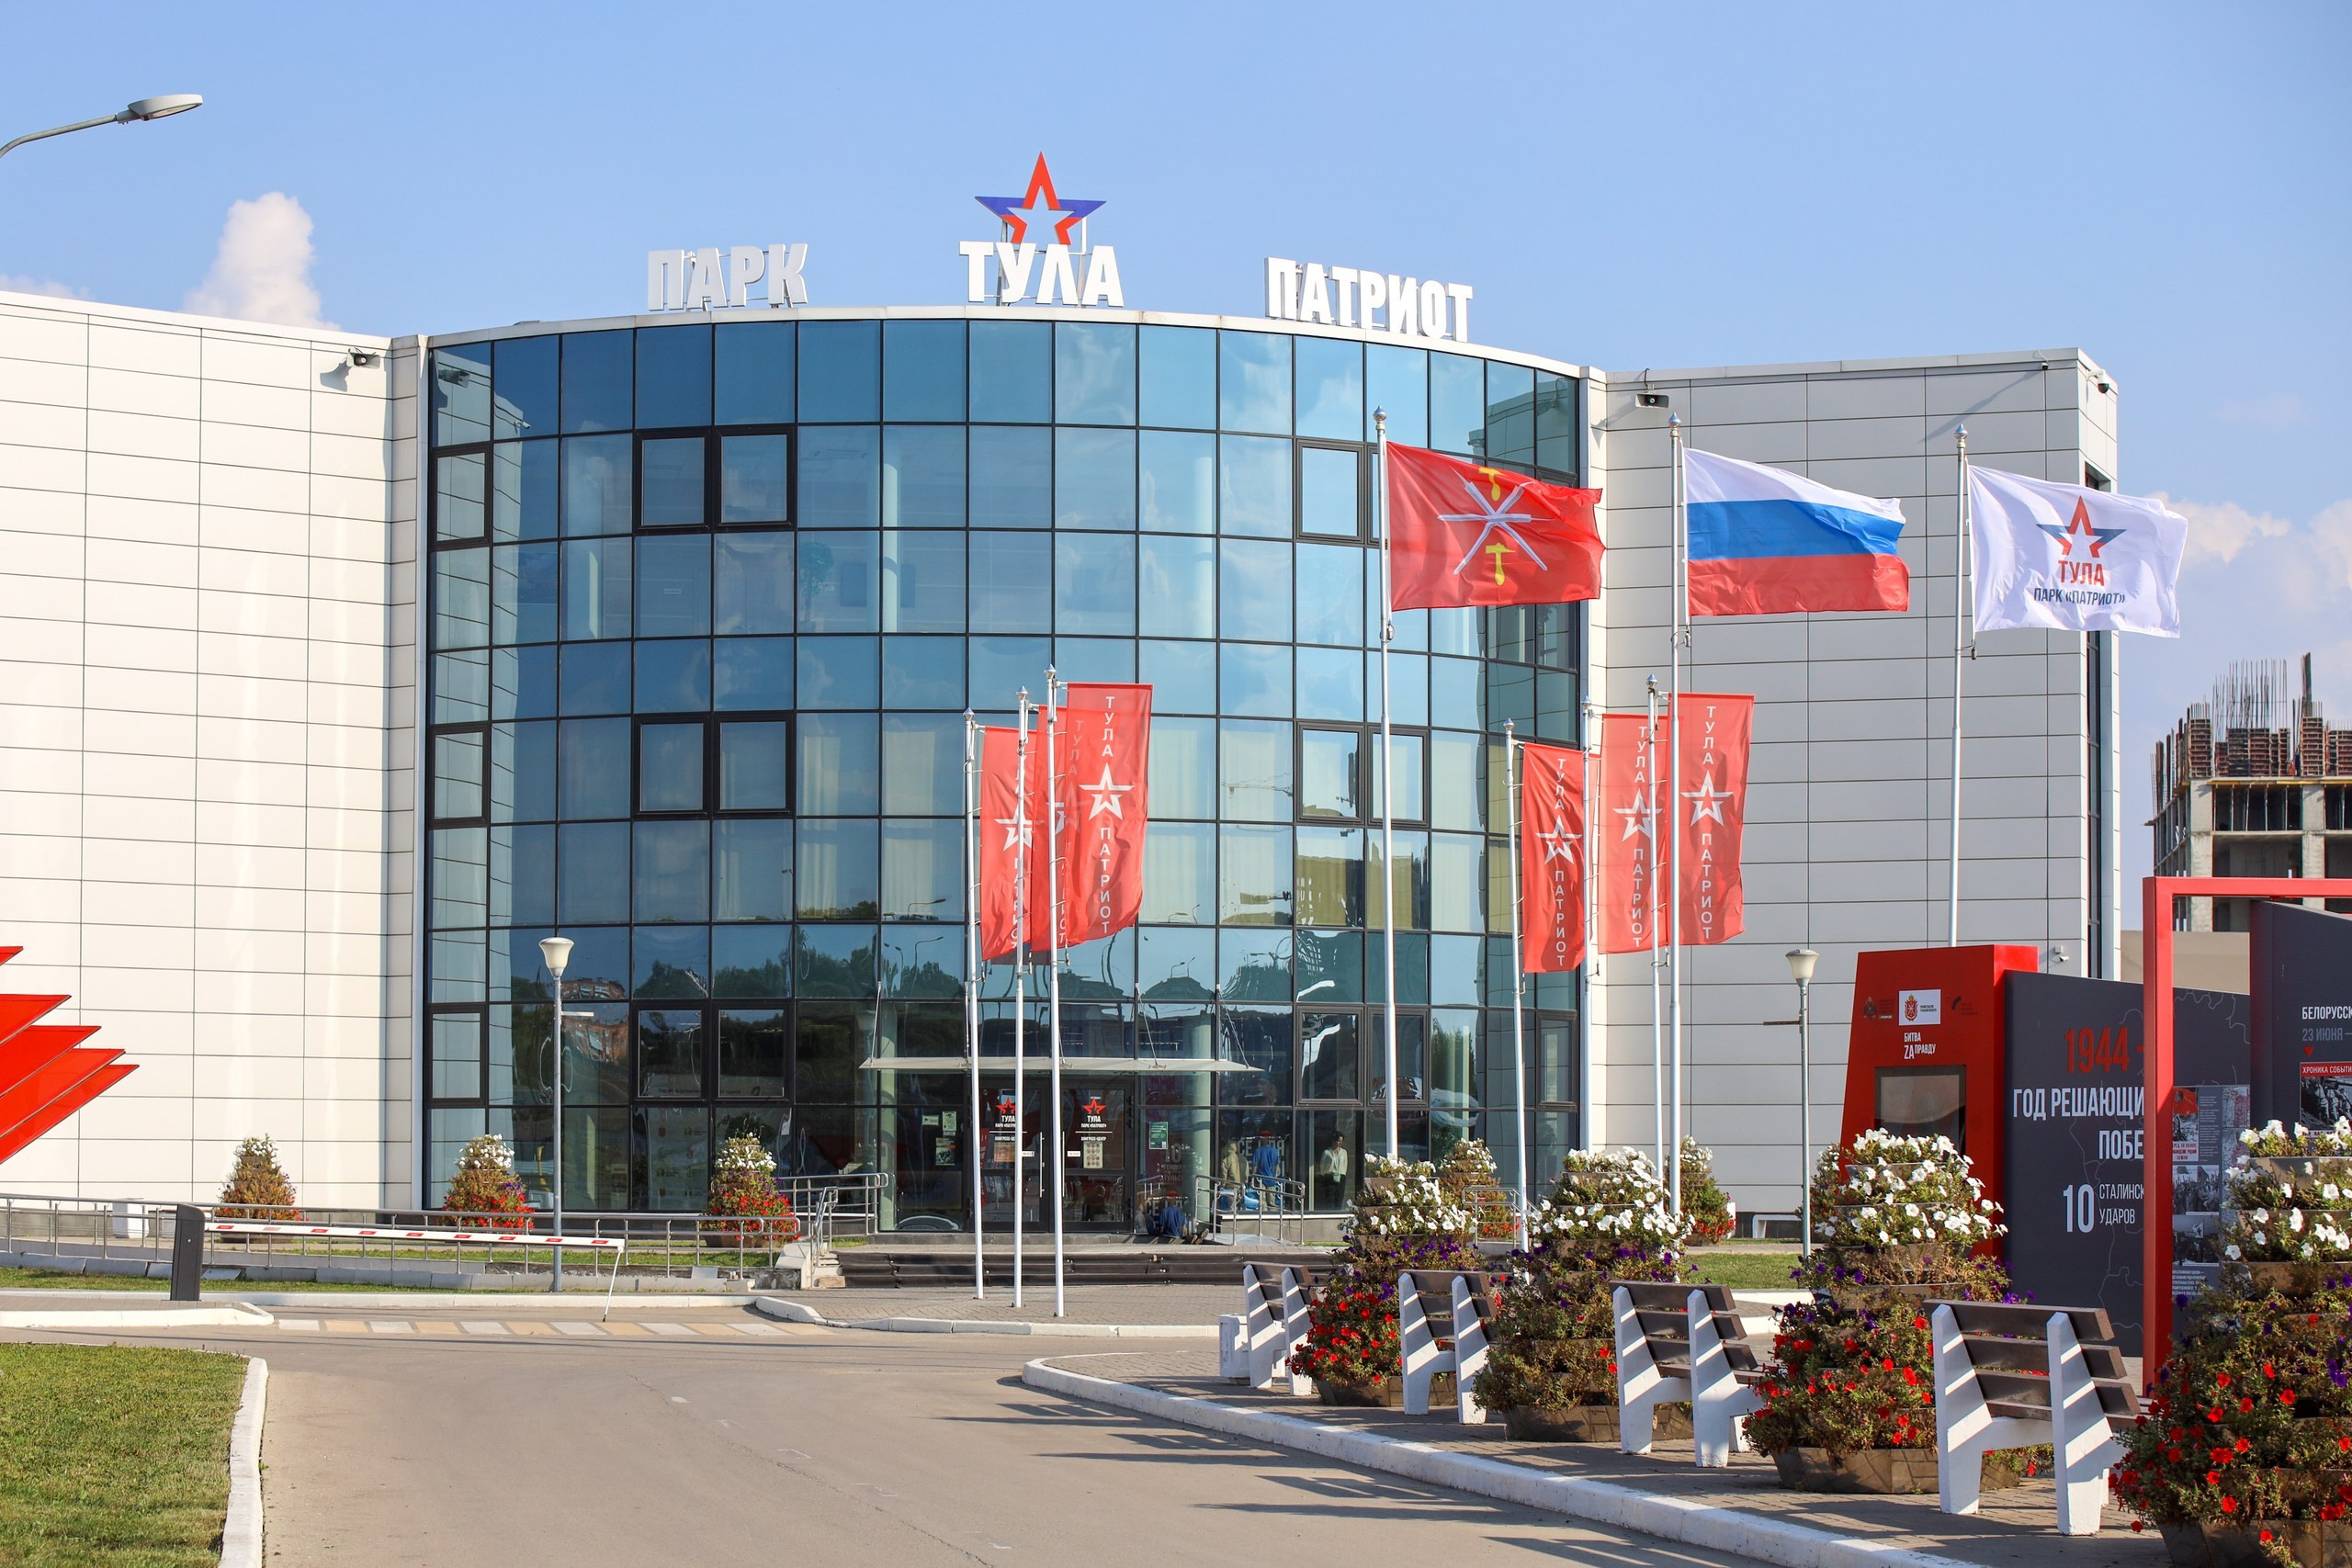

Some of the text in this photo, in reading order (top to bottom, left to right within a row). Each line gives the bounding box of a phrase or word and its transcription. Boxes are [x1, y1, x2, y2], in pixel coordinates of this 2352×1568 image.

[648, 241, 1473, 343] ПАРК ТУЛА ПАТРИОТ
[2058, 559, 2105, 587] ТУЛА
[2033, 587, 2126, 606] ПАРК «ПАТРИОТ»
[1100, 696, 1115, 933] ТУЛА ПАТРИОТ
[1701, 705, 1716, 939] ТУЛА ПАТРИОТ
[1632, 727, 1648, 948] ТУЛА ПАТРИОТ
[1555, 759, 1566, 966] ТУЛА ПАТРИОТ
[1904, 1032, 1922, 1043] БИТВА
[1914, 1043, 1937, 1055] ПРАВДУ
[2064, 1026, 2131, 1074] 1944
[2301, 1027, 2344, 1042] 23 ИЮНЯ
[2301, 1066, 2329, 1074] ХРОНИКА
[2013, 1088, 2047, 1122] ГОД
[2063, 1183, 2095, 1234] 10
[2099, 1207, 2136, 1226] УДАРОВ
